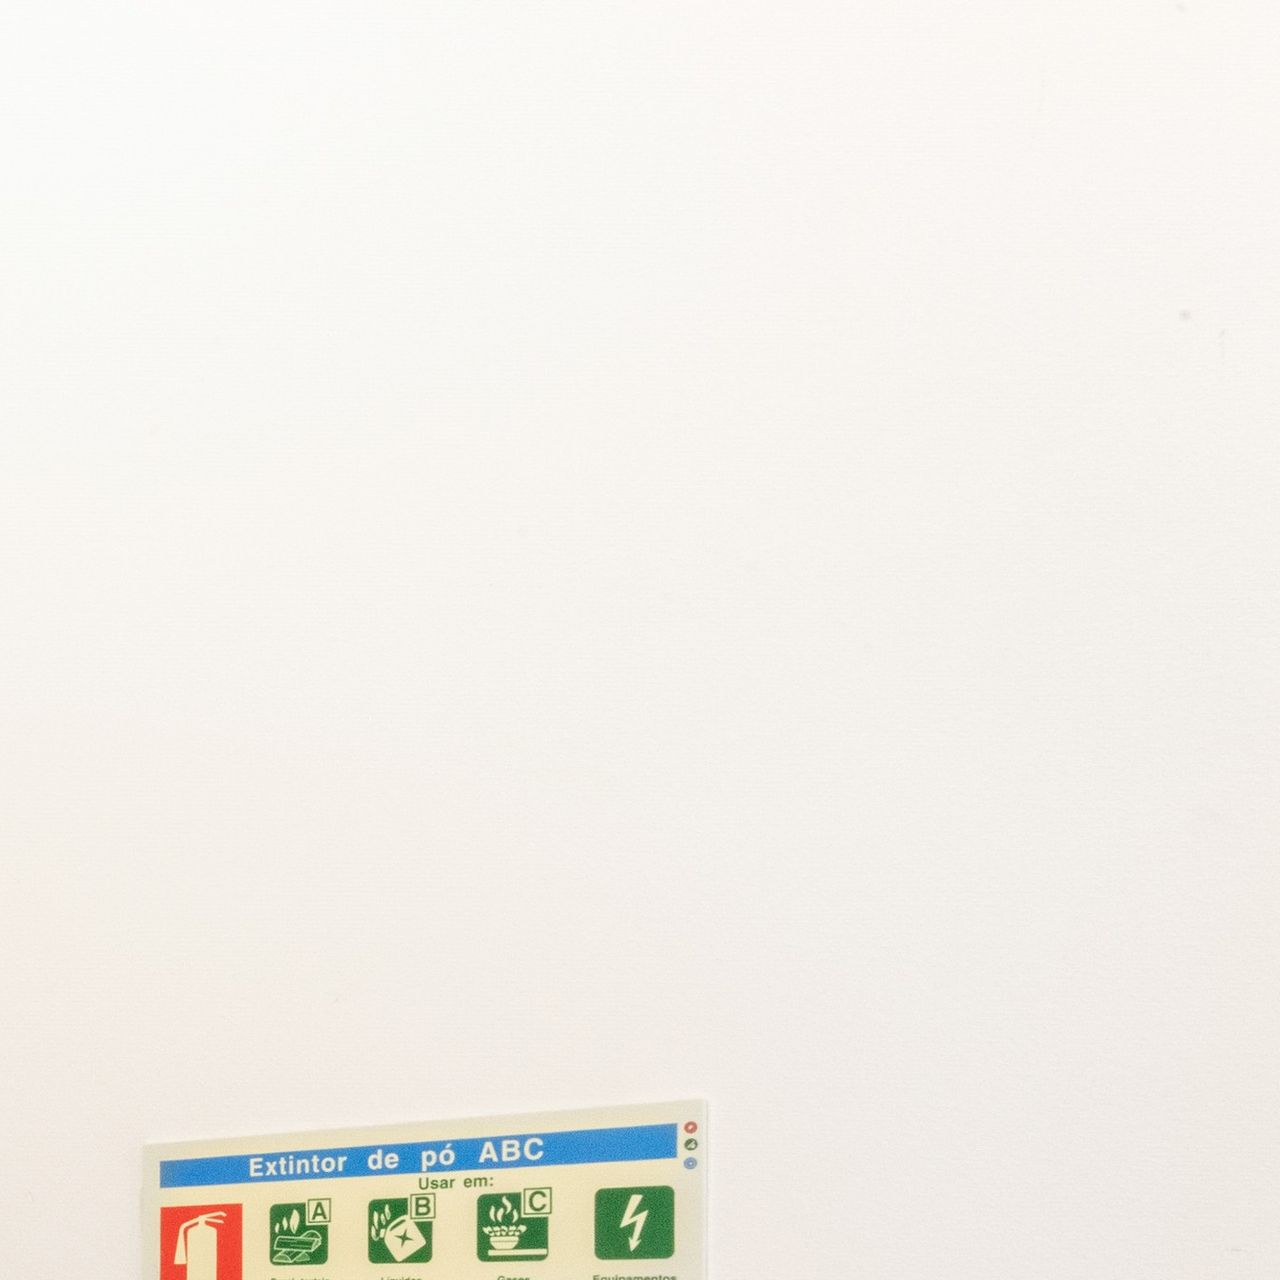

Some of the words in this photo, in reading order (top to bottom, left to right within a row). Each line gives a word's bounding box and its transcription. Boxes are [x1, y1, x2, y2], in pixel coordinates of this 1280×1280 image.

[249, 1155, 347, 1177] Extintor
[367, 1149, 399, 1170] de
[421, 1143, 455, 1171] pó
[479, 1138, 544, 1163] ABC
[418, 1176, 456, 1190] Usar
[464, 1175, 494, 1188] em:
[415, 1196, 431, 1216] B
[529, 1190, 547, 1211] C
[312, 1202, 327, 1221] A
